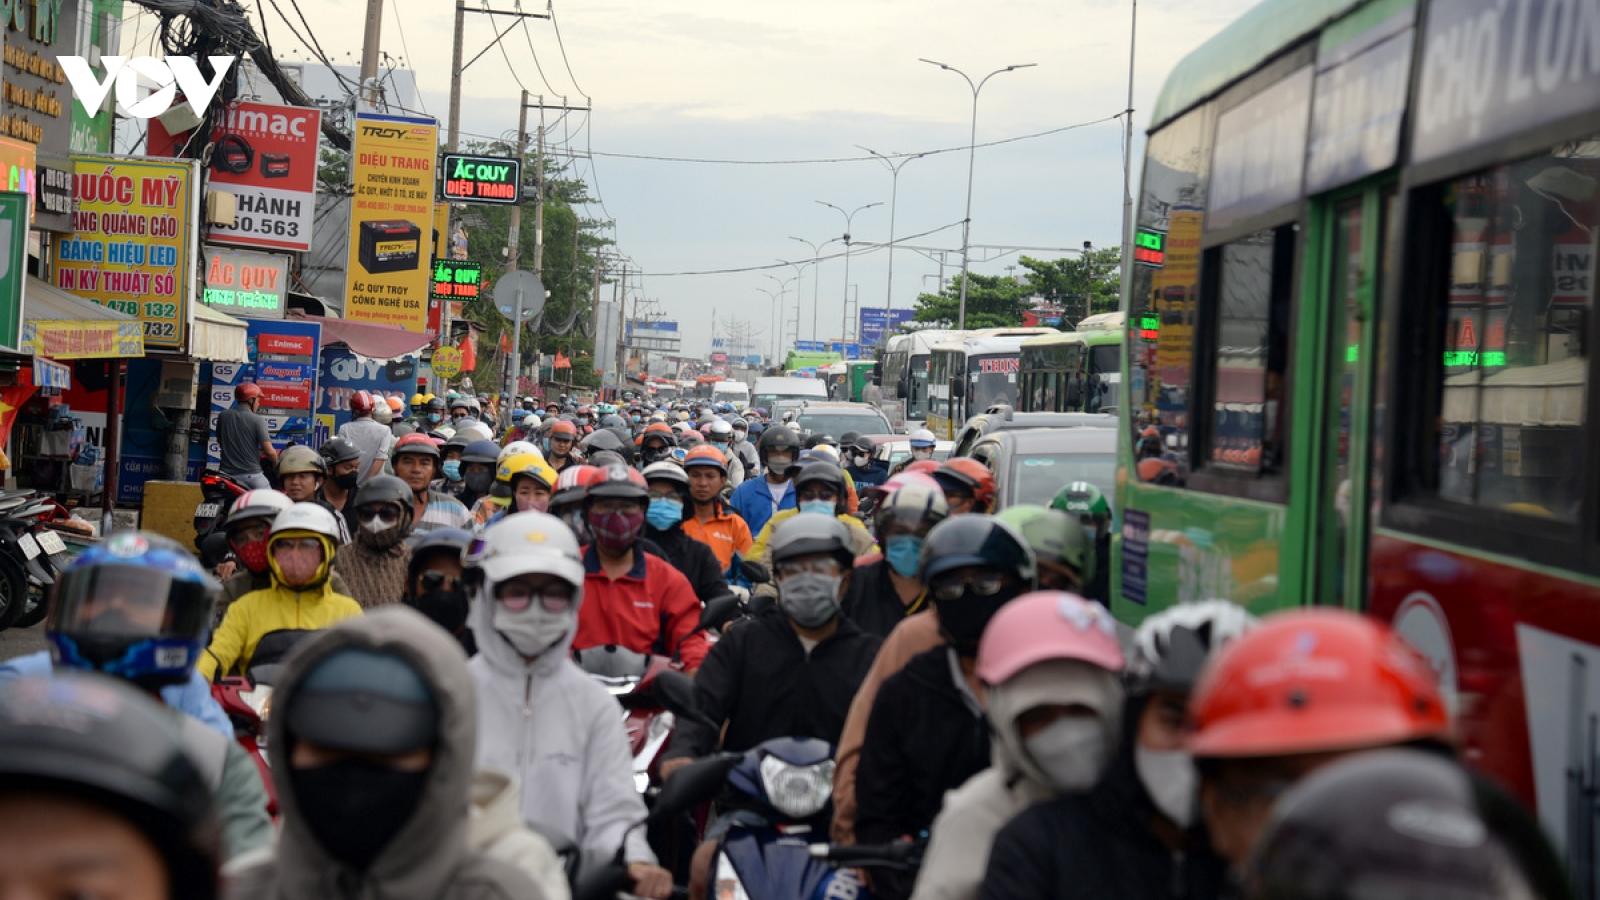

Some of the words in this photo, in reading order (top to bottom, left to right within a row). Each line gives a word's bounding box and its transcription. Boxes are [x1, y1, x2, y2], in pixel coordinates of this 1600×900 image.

[362, 126, 408, 139] TROY
[359, 151, 388, 169] DIỆU
[391, 156, 430, 171] TRANG
[476, 164, 510, 182] QUY
[141, 175, 180, 207] MỸ
[447, 180, 474, 198] DIỆU
[477, 183, 515, 199] TRANG
[234, 192, 301, 217] HÀNH
[102, 209, 146, 236] QUẢNG
[150, 213, 177, 237] CÁO
[60, 235, 103, 263] BẢNG
[107, 240, 145, 268] HIỆU
[148, 245, 177, 267] LED
[59, 268, 75, 289] IN
[103, 269, 151, 298] THUẬT
[154, 267, 175, 296] SỐ
[240, 265, 279, 290] QUY
[454, 268, 480, 284] QUY
[367, 284, 385, 294] QUY
[387, 286, 409, 295] TROY
[453, 284, 478, 297] TRANG
[143, 302, 176, 319] 132
[352, 295, 376, 306] CÔNG
[403, 301, 420, 309] USA
[274, 340, 302, 349] Enimac
[214, 365, 233, 375] GS
[330, 357, 380, 382] QUY
[212, 391, 232, 401] GS
[271, 393, 300, 403] Enimac
[265, 418, 278, 429] S
